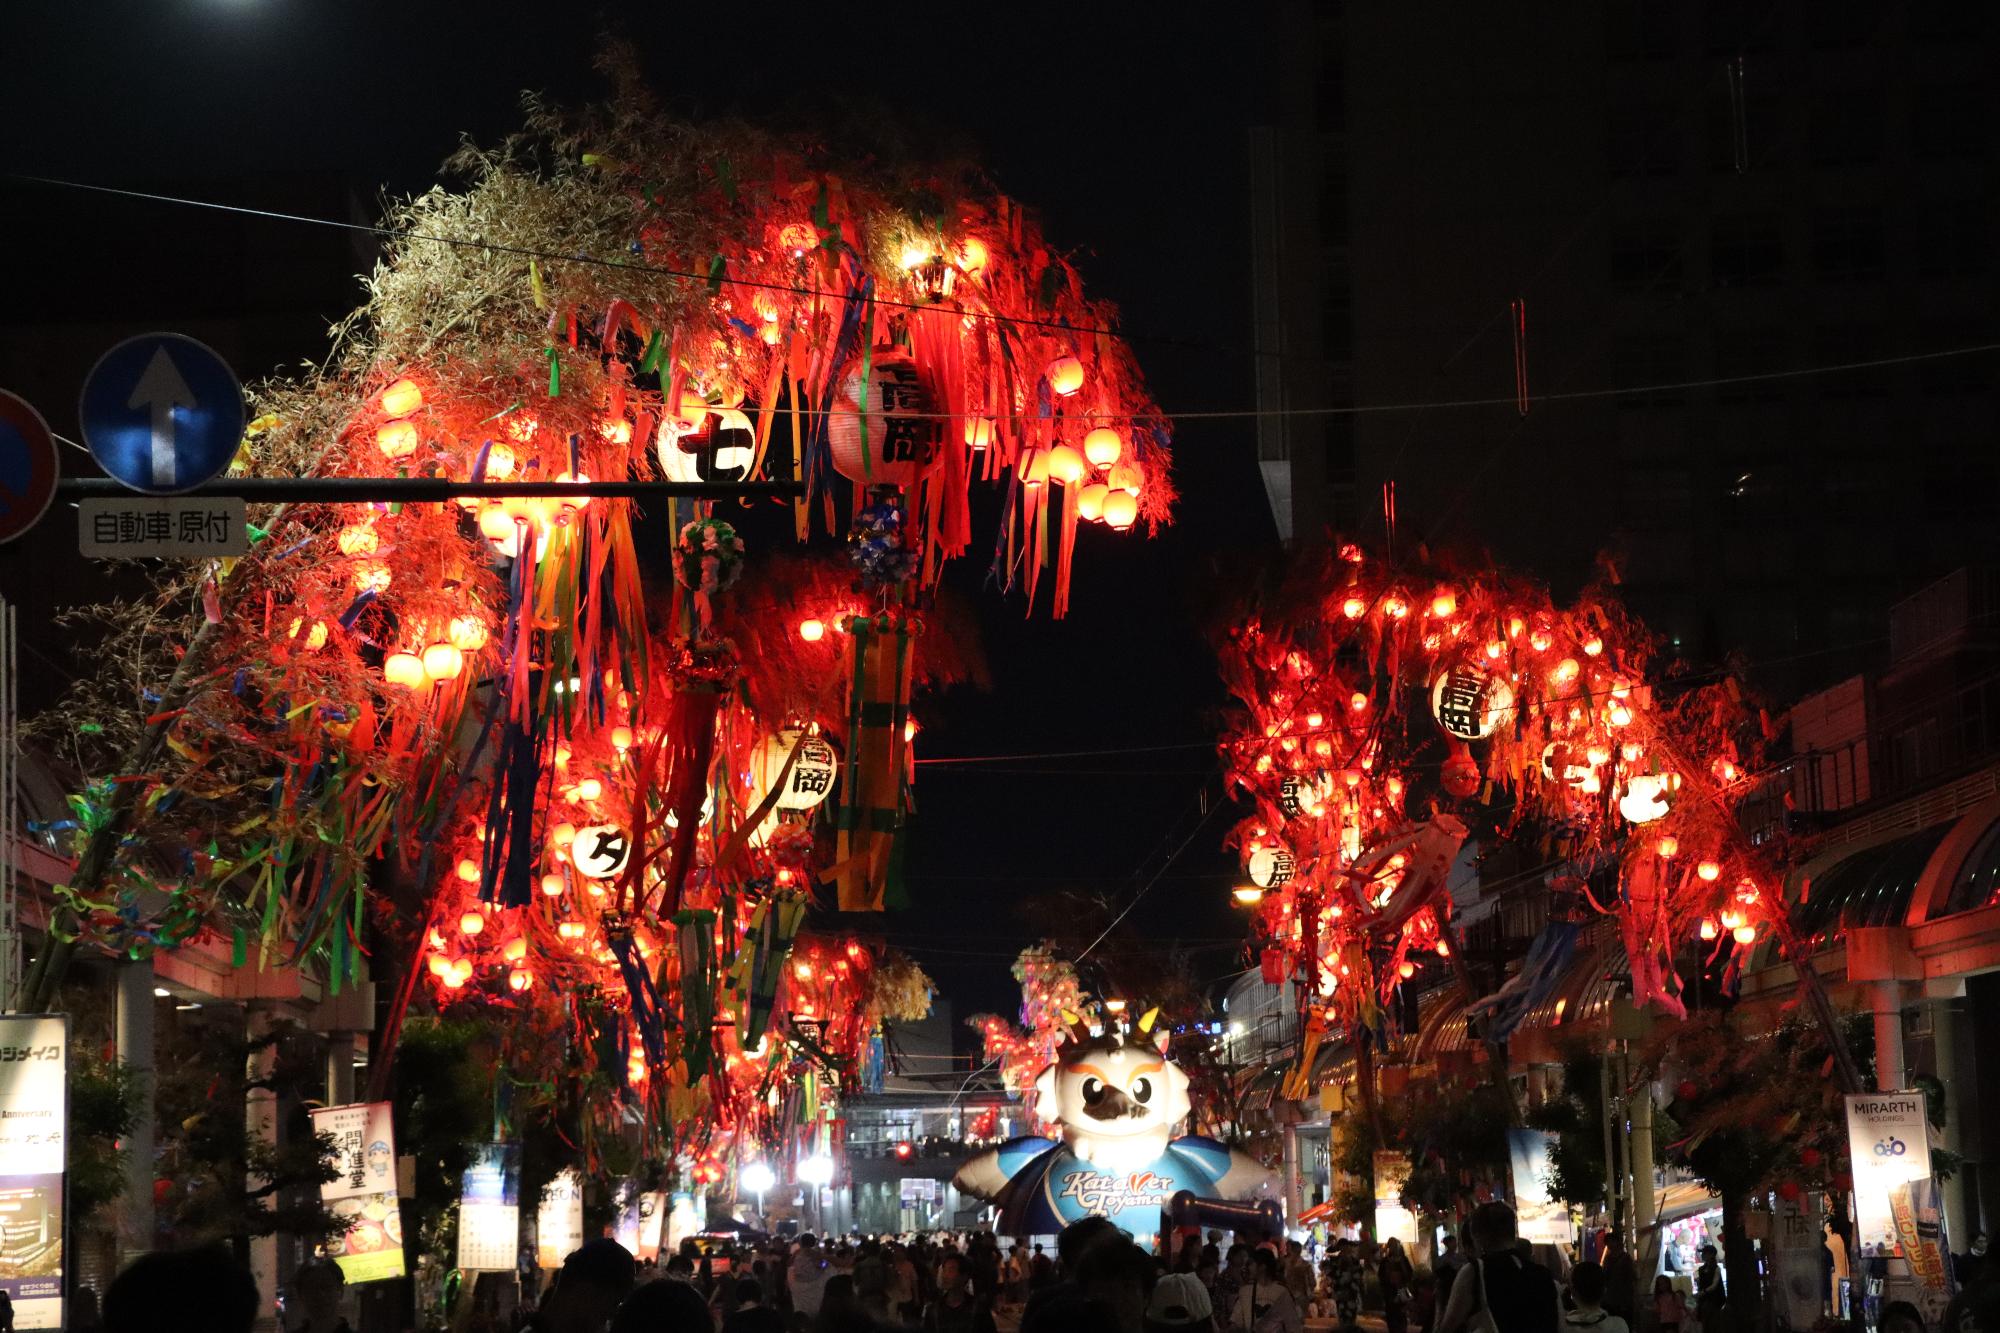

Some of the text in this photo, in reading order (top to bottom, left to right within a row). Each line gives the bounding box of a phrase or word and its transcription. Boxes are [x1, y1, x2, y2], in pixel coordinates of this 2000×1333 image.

[94, 510, 231, 544] 自動車・原付
[0, 1046, 60, 1062] ジメイク
[2, 1109, 53, 1120] Anniversary
[1854, 1101, 1917, 1114] MIRARTH
[1868, 1114, 1905, 1123] HOLDINGS
[345, 1130, 367, 1190] 開進堂
[1080, 1191, 1163, 1217] Toyama
